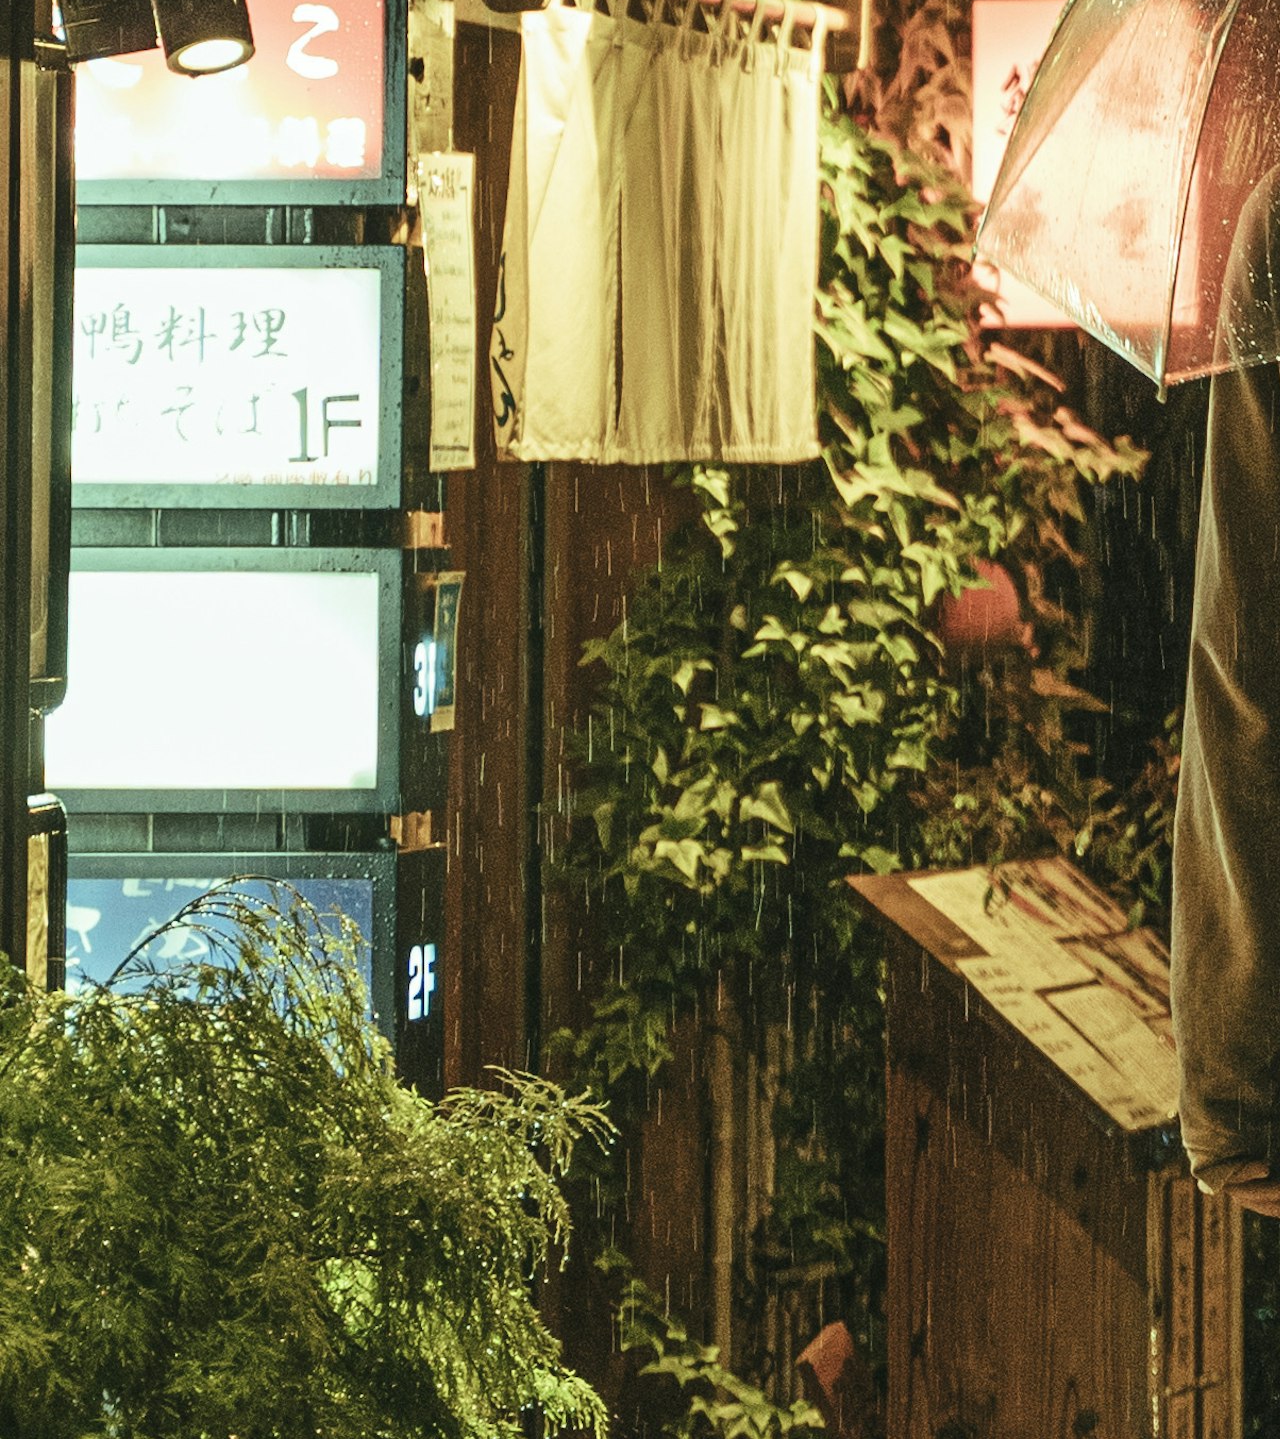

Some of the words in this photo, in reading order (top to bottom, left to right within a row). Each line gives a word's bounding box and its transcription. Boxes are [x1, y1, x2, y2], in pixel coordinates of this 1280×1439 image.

[80, 302, 289, 366] 鴨料理
[288, 386, 363, 463] 1F
[407, 943, 436, 1021] 2F
